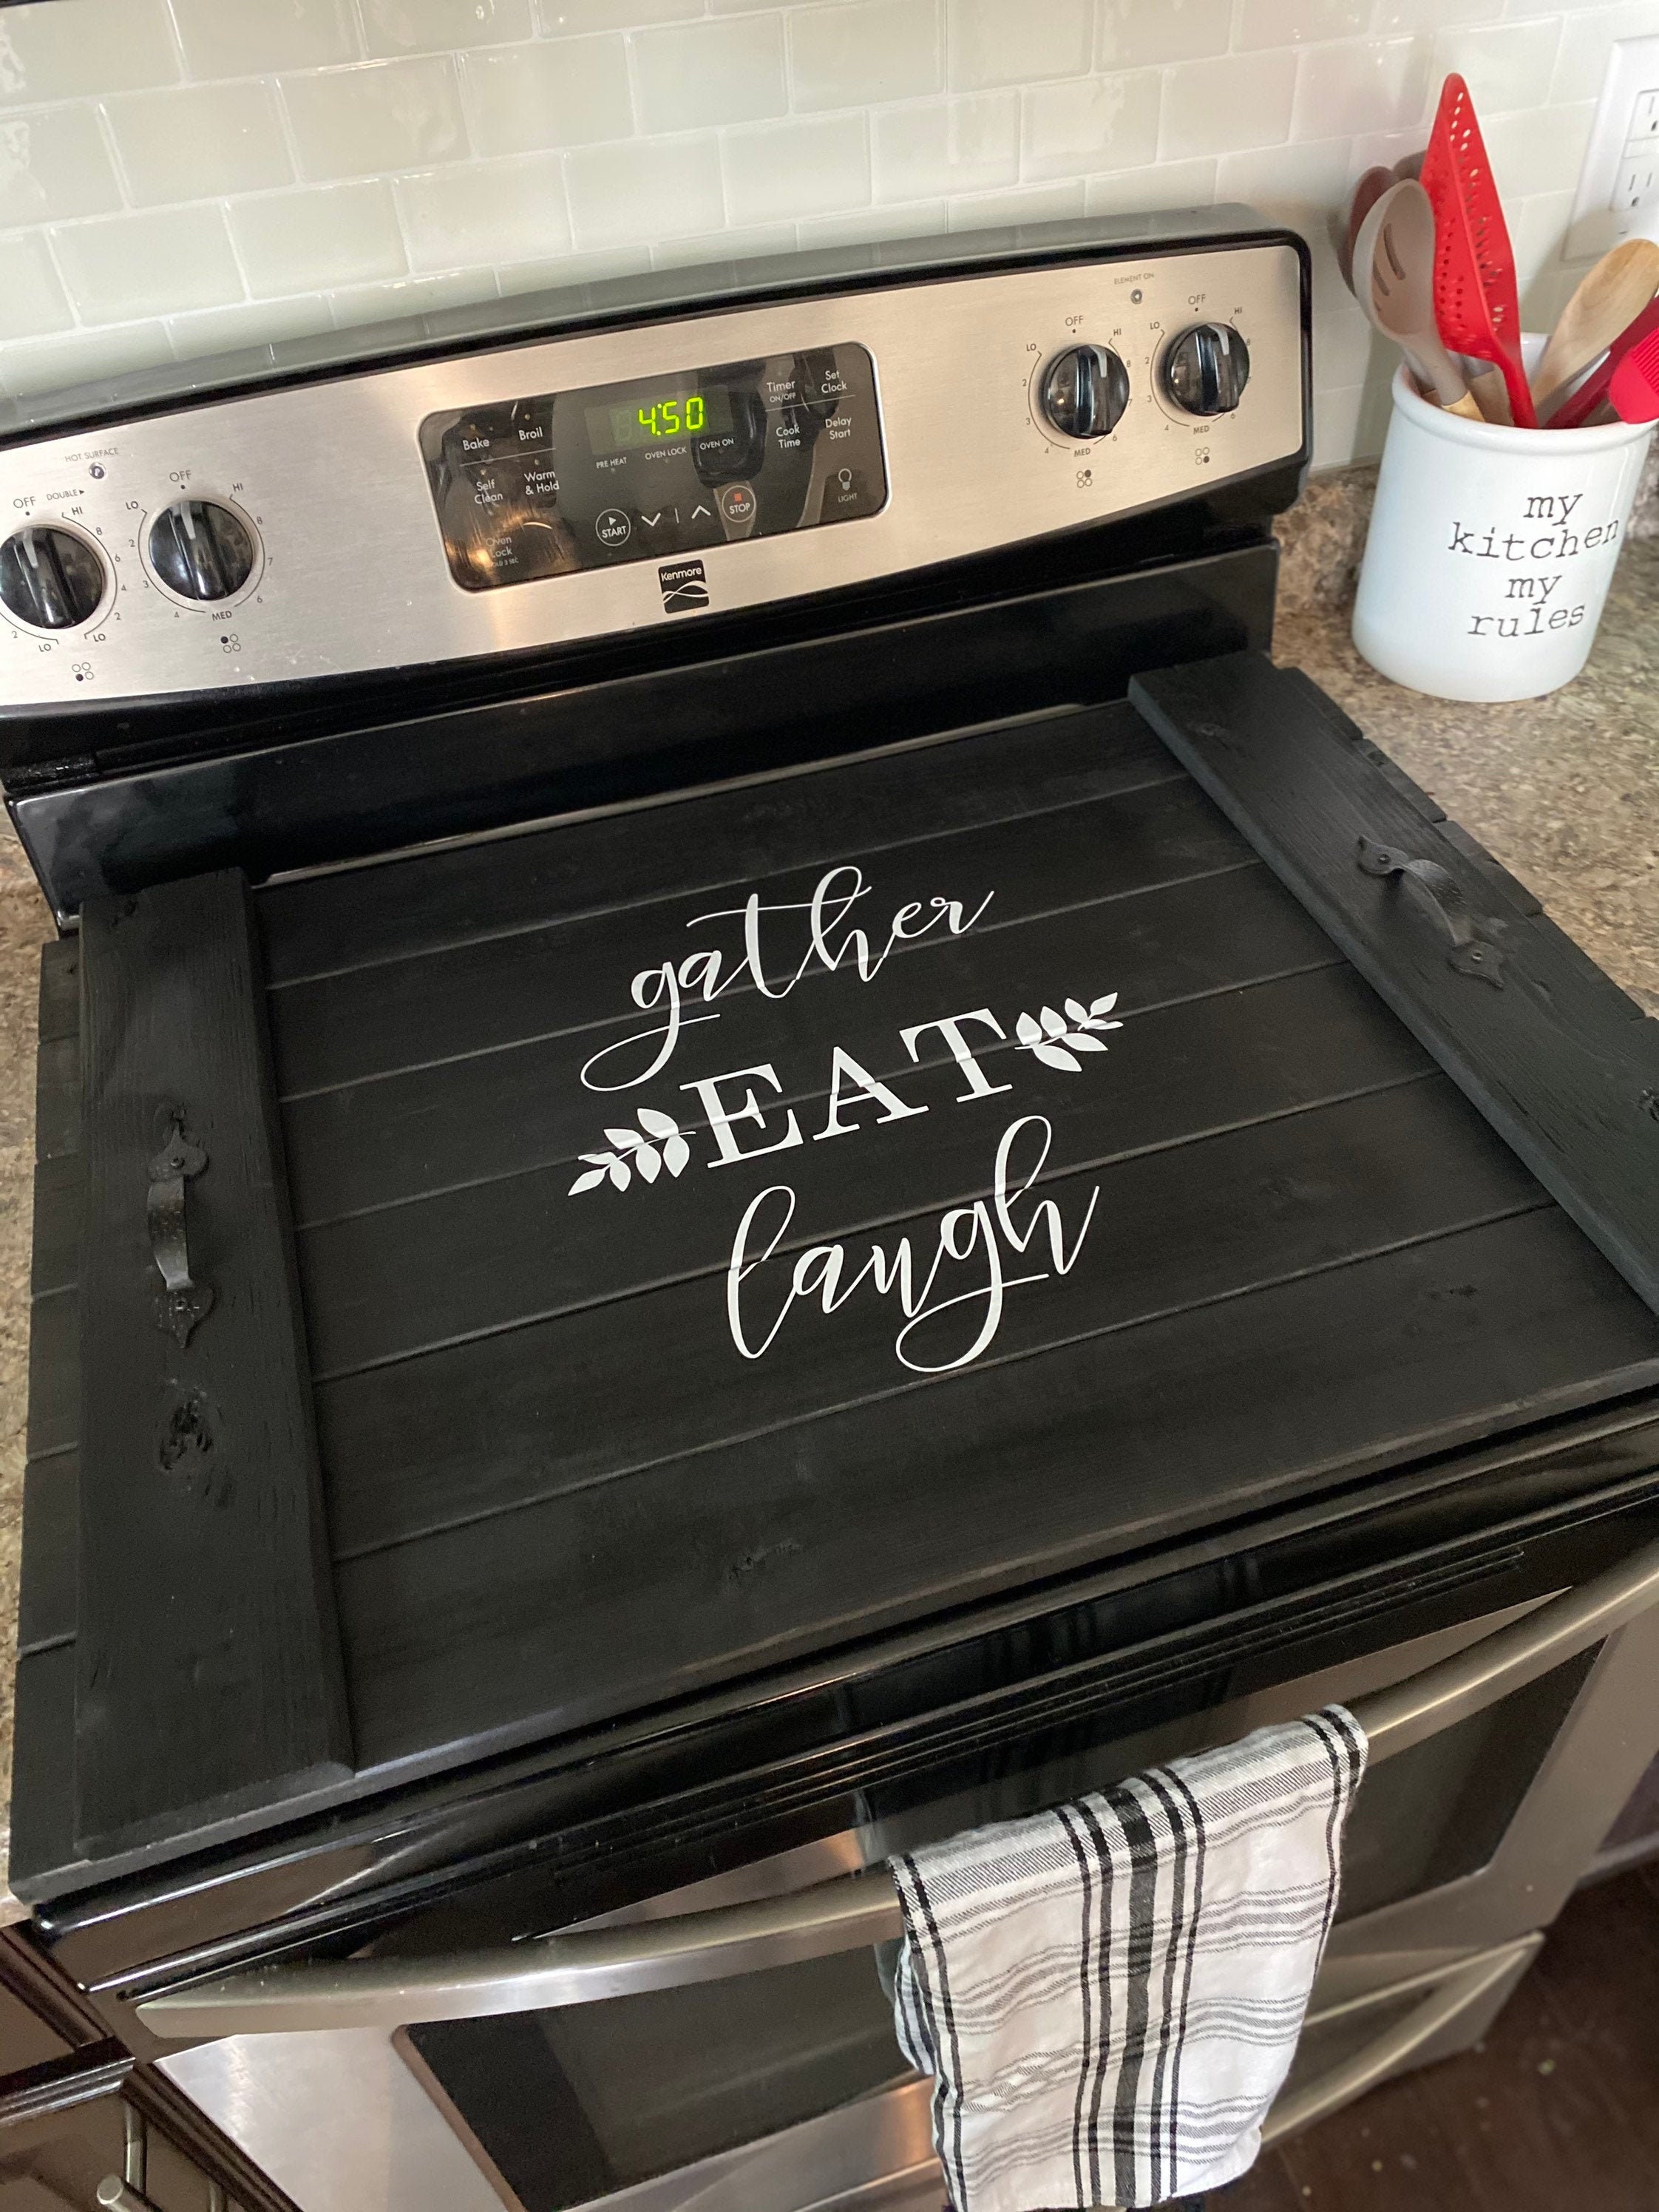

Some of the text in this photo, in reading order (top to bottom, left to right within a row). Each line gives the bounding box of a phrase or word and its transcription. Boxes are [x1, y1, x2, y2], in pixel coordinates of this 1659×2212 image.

[1113, 272, 1155, 285] ELEMENT ON
[1187, 294, 1206, 305] OFF
[1065, 316, 1084, 327] OFF
[1150, 321, 1160, 330] LO
[1026, 343, 1037, 352] LO
[1144, 356, 1150, 364] 2
[825, 370, 840, 381] Set
[767, 380, 796, 393] Timer
[821, 381, 848, 395] Clock
[1022, 379, 1028, 387] 2
[770, 393, 796, 403] ON/OFF
[1230, 411, 1235, 419] 6
[824, 416, 852, 430] Delay
[518, 427, 543, 441] Broil
[776, 425, 801, 438] Cook
[829, 429, 852, 441] Start
[1192, 424, 1210, 435] MED
[778, 438, 801, 449] Time
[1113, 434, 1118, 442] 6
[462, 438, 490, 451] Bake
[699, 438, 735, 451] OVEN ON
[65, 447, 119, 463] HOT SURFACE
[645, 446, 688, 461] OVEN LOCK
[1073, 447, 1092, 458] MED
[596, 456, 628, 469] PRE HEAT
[169, 470, 192, 482] OFF
[523, 470, 556, 482] Warm
[232, 483, 244, 492] HI
[476, 479, 495, 492] Self
[525, 480, 560, 495] & Hold
[47, 489, 78, 501] DOUBLE
[474, 492, 503, 505] Clean
[838, 492, 858, 503] LIGHT
[13, 496, 36, 509] OFF
[126, 501, 139, 510] LO
[72, 506, 83, 515] HI
[729, 502, 751, 515] STOP
[1523, 493, 1583, 526] my
[257, 517, 263, 525] 8
[96, 527, 103, 535] 8
[601, 525, 627, 539] START
[129, 539, 135, 548] 2
[485, 536, 512, 547] Oven
[1448, 520, 1619, 561] kitchen
[490, 546, 513, 559] Lock
[115, 554, 121, 563] 6
[268, 557, 274, 566] 7
[661, 567, 702, 582] Kenmore
[143, 580, 150, 588] 3
[1504, 574, 1563, 606] my
[257, 596, 263, 604] 6
[114, 612, 122, 620] 2
[211, 611, 233, 621] MED
[1467, 603, 1586, 638] rules
[12, 631, 18, 639] 2
[93, 633, 106, 642] LO
[38, 643, 52, 652] LO
[580, 866, 995, 1091] gather
[679, 1008, 1014, 1169] EAT
[727, 1115, 1100, 1373] laugh
